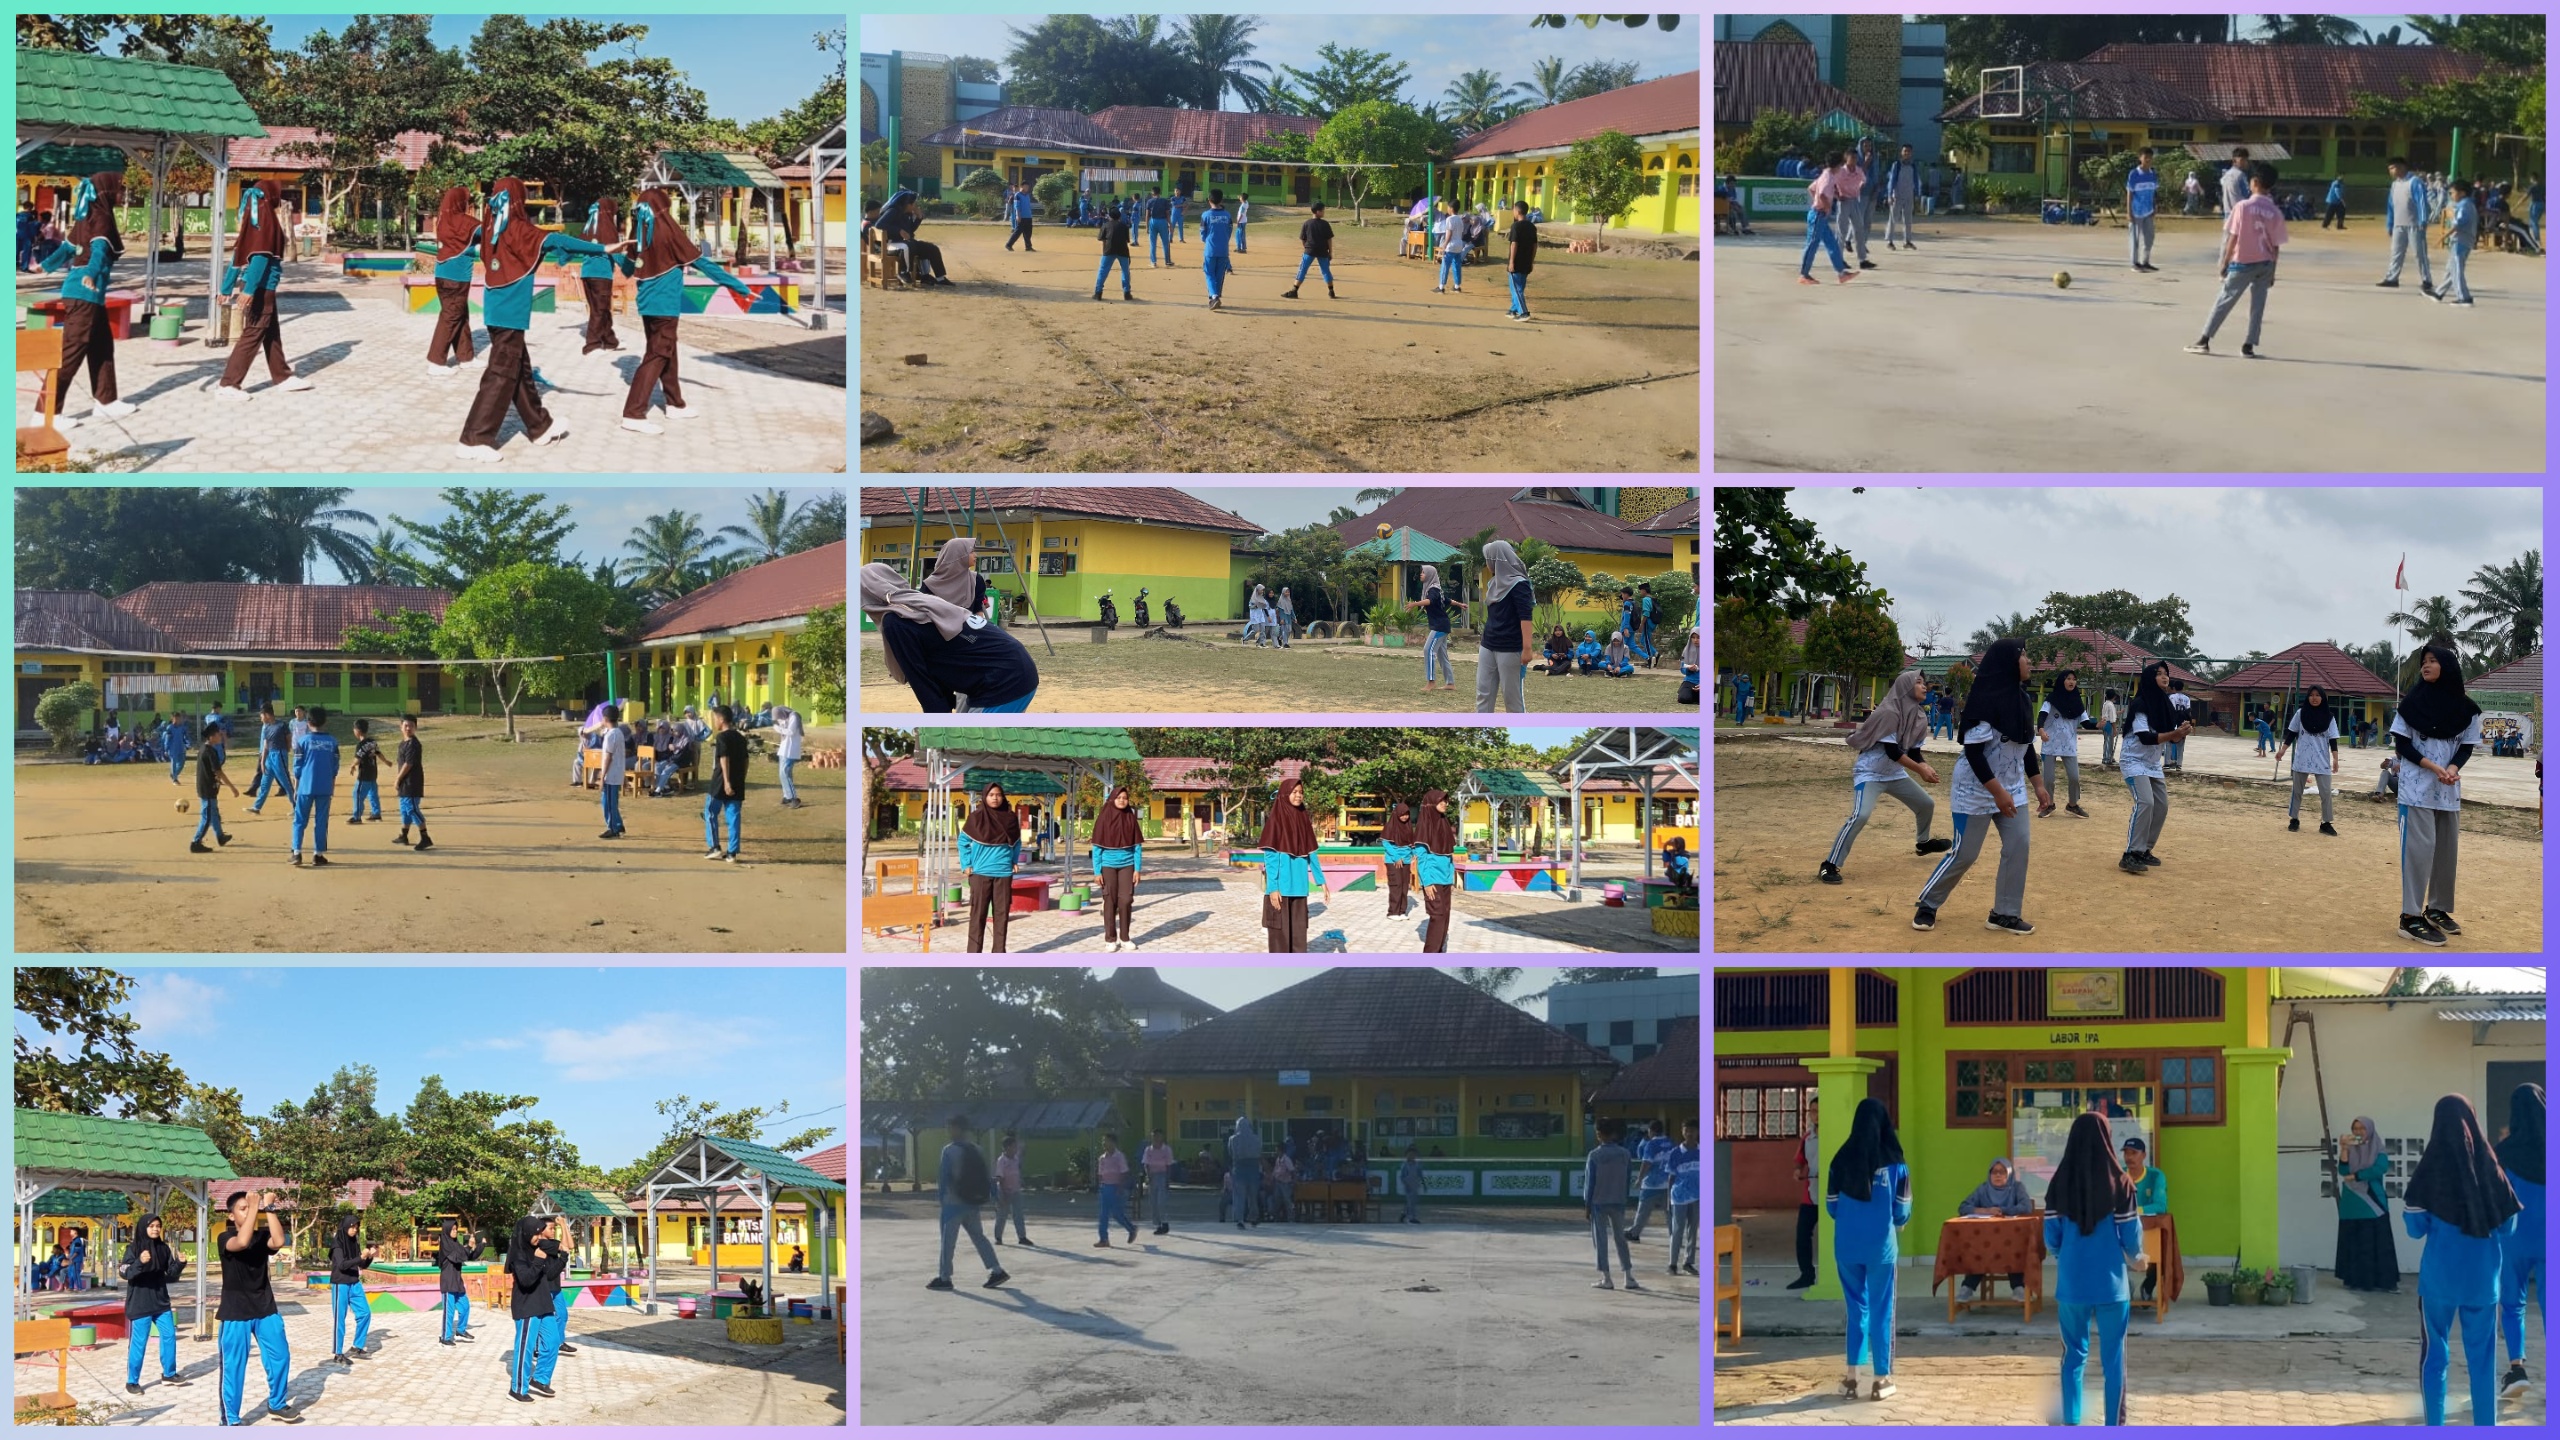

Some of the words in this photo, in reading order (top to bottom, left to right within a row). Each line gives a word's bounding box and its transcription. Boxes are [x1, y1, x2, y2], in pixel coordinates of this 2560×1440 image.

[2483, 718, 2506, 727] CLASS
[2507, 718, 2517, 727] OF
[2050, 1032, 2080, 1044] LABOR
[2085, 1032, 2100, 1044] IPA
